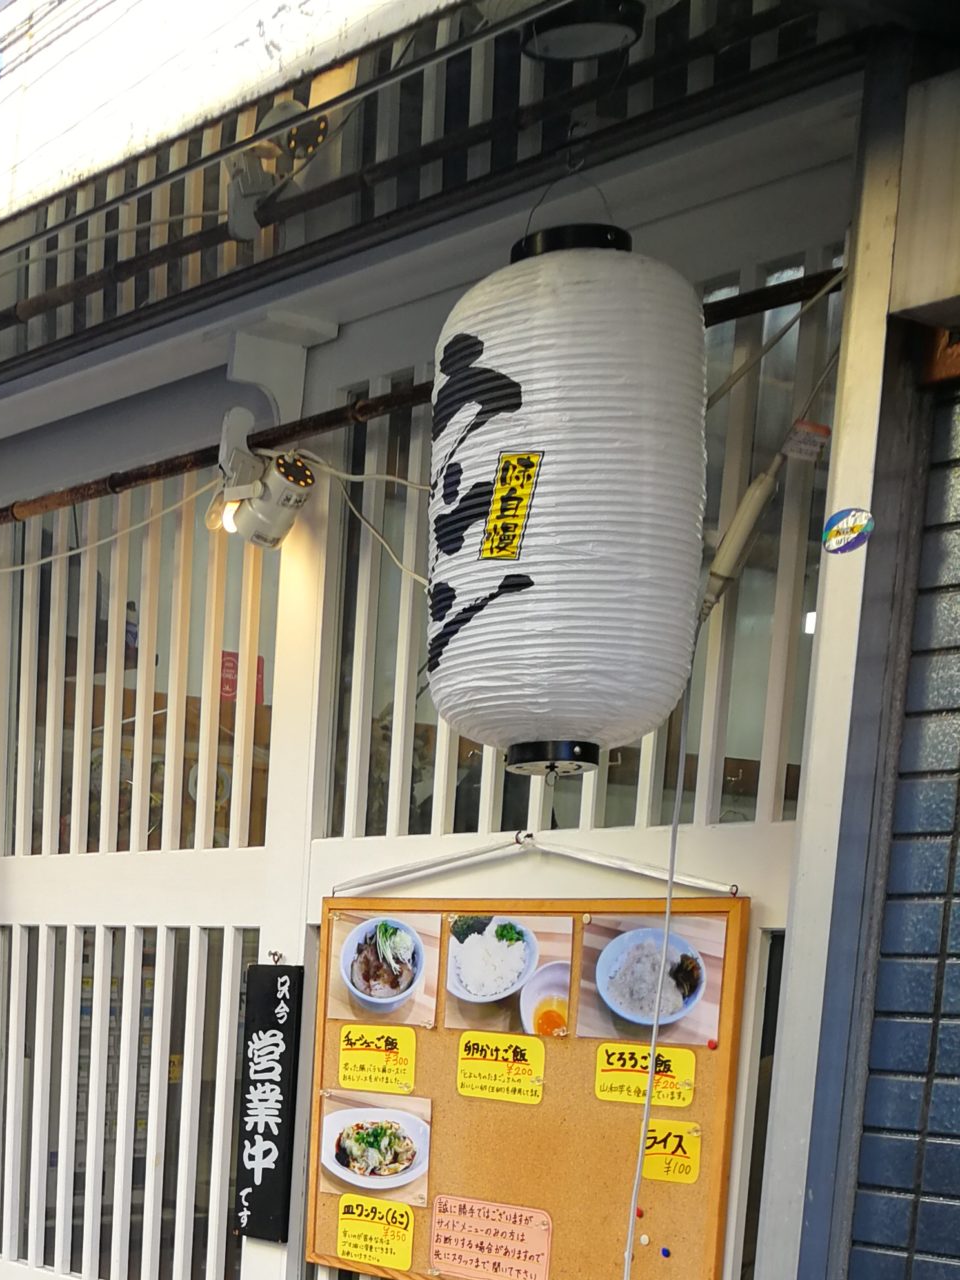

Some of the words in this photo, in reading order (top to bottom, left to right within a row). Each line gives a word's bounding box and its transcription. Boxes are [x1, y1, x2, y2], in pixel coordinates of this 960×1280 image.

[486, 455, 534, 557] 味自慢
[275, 975, 290, 1025] 只今
[385, 1052, 408, 1066] ¥300
[463, 1040, 528, 1062] 卵かけご飯
[605, 1049, 673, 1073] とろろご飯
[506, 1063, 533, 1076] ¥200
[242, 1029, 286, 1186] 営業中
[645, 1128, 687, 1155] ライス
[664, 1158, 691, 1176] ¥100
[238, 1187, 253, 1228] です
[437, 1199, 534, 1225] 誠に勝手ではございますが
[383, 1226, 406, 1242] ¥350
[437, 1218, 526, 1242] サイドメニューのみの方は
[435, 1233, 545, 1264] お断りする場合がありますので
